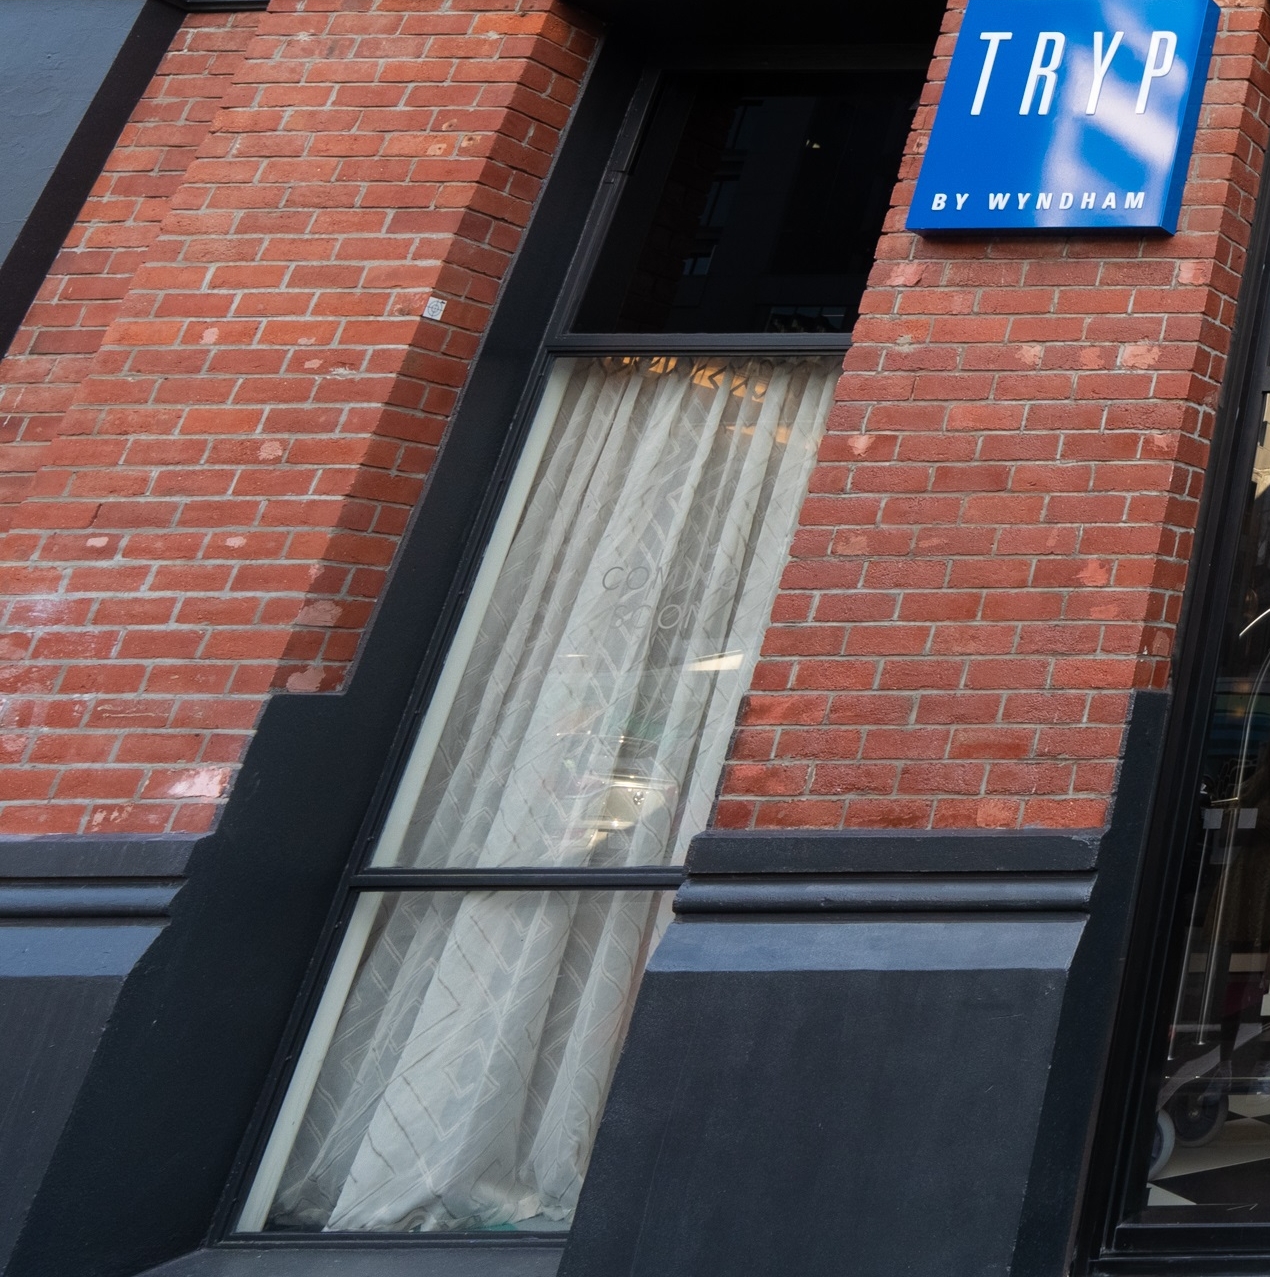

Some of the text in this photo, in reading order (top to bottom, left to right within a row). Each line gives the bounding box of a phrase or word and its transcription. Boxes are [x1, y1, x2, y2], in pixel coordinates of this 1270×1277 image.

[969, 31, 1178, 116] TRYP
[931, 191, 1145, 211] BY WYNDHAM
